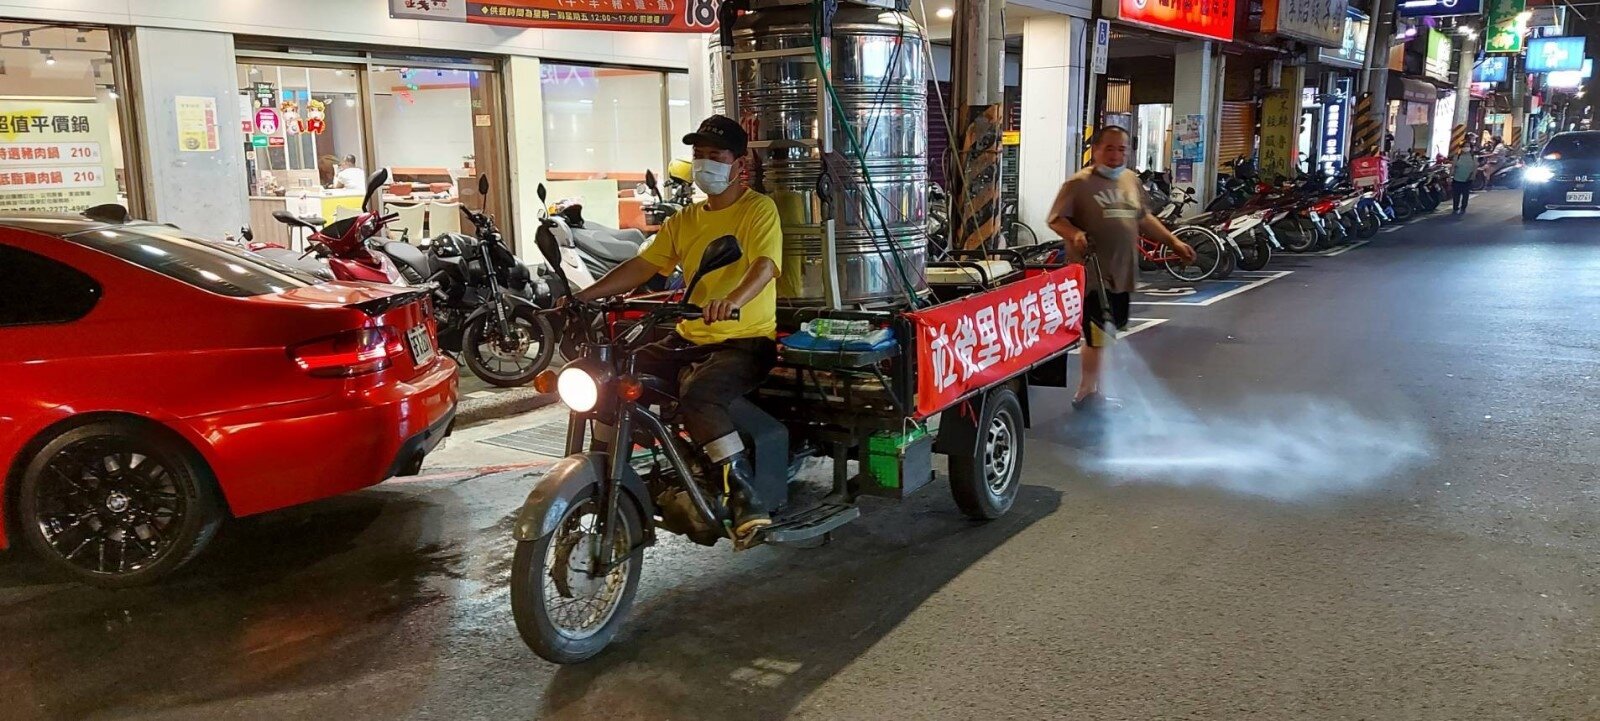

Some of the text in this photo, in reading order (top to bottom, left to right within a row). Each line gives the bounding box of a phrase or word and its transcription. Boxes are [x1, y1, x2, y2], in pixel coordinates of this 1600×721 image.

[685, 0, 721, 27] 18
[71, 147, 91, 158] 210
[74, 171, 95, 182] 210
[928, 278, 1082, 394] 社後里防疫專車
